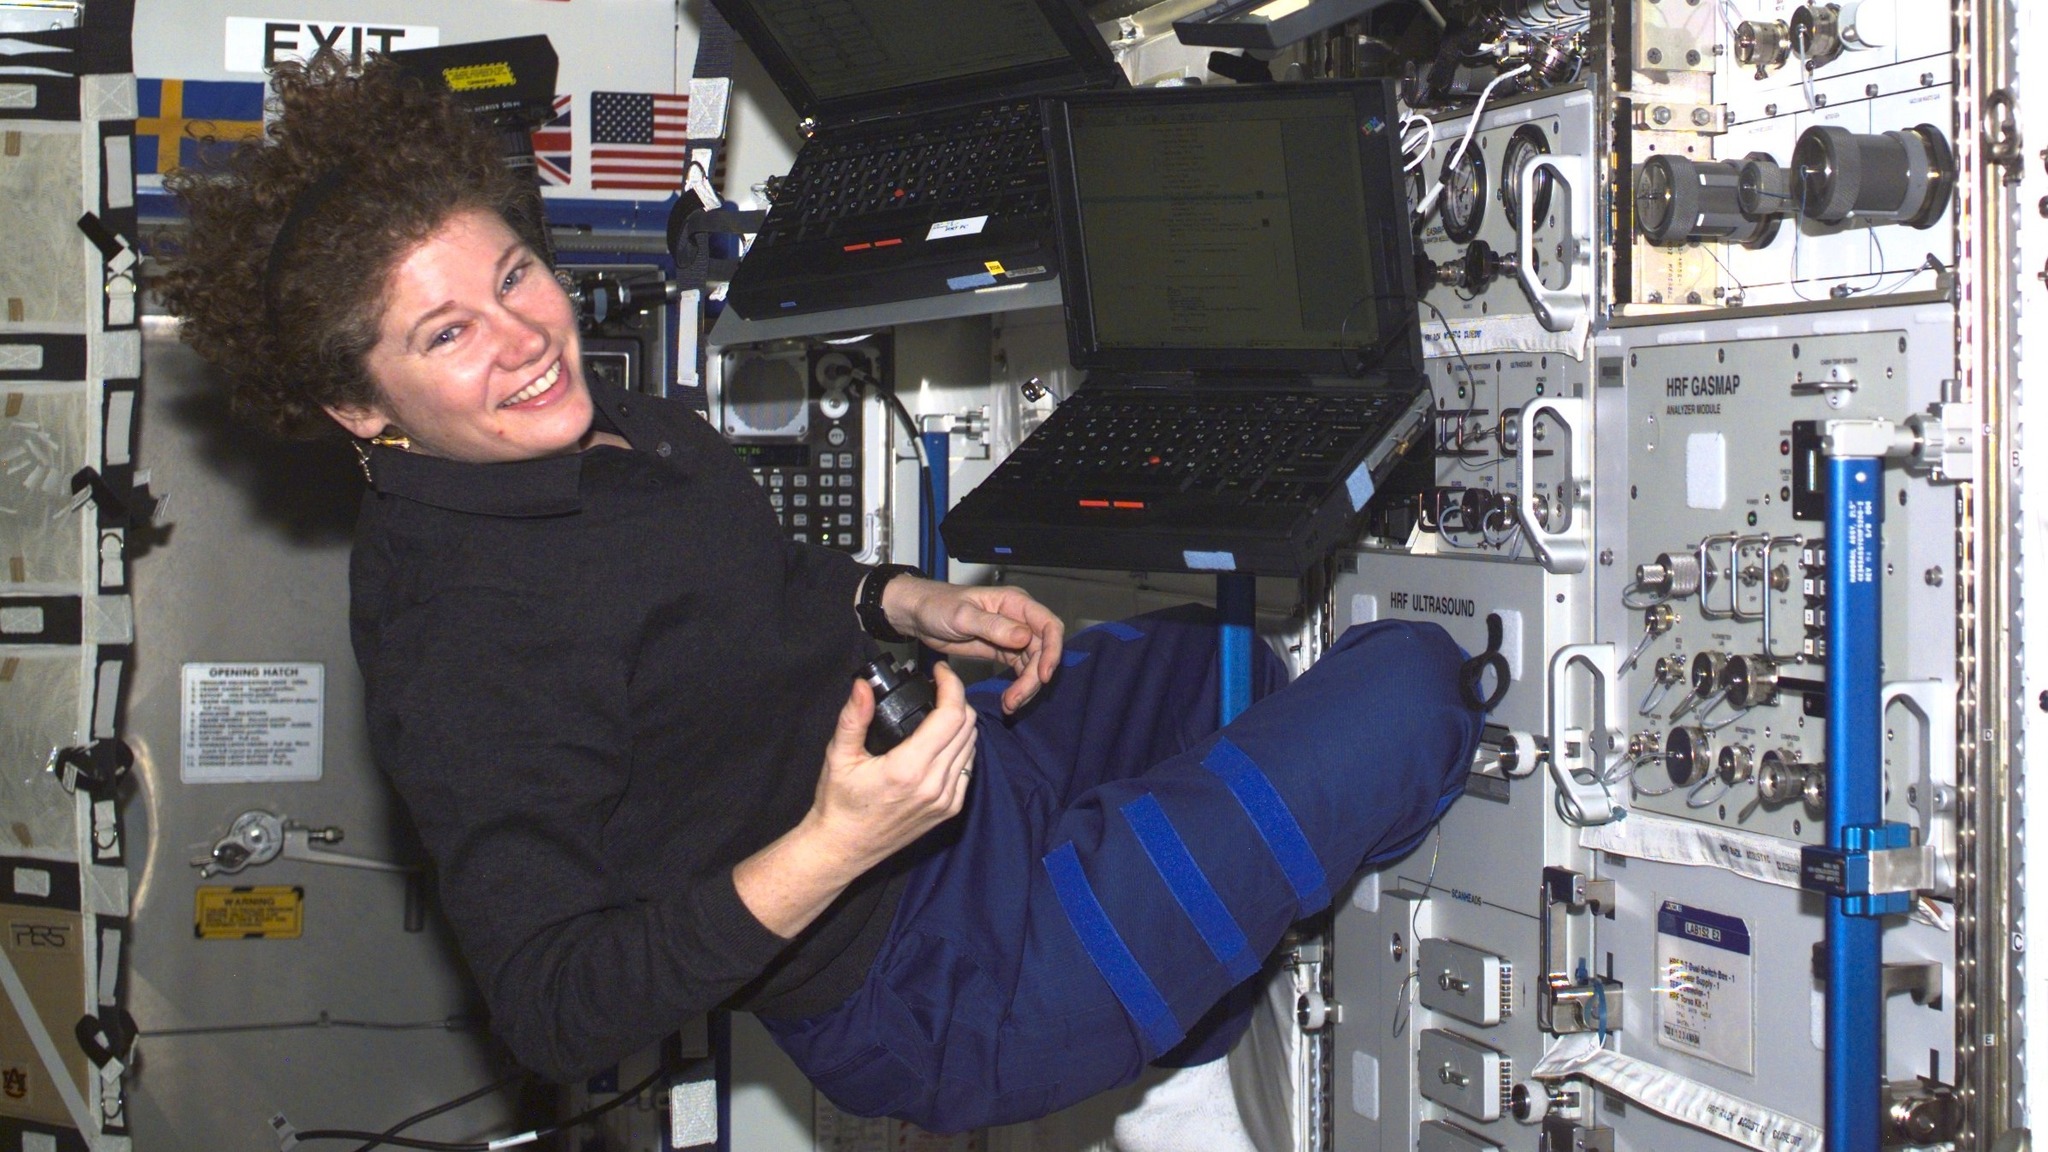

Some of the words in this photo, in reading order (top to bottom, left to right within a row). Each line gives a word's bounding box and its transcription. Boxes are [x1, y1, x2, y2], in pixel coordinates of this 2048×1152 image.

[264, 22, 406, 71] EXIT
[1360, 116, 1380, 136] IBM
[1666, 377, 1688, 397] HRF
[1692, 374, 1740, 396] GASMAP
[1666, 405, 1695, 415] ANALYZER
[1697, 404, 1721, 414] MODULE
[1390, 592, 1408, 609] HRF
[1412, 594, 1475, 617] ULTRASOUND
[209, 667, 259, 677] OPENING
[264, 667, 298, 677] HATCH
[224, 898, 275, 906] WARNING
[1451, 888, 1482, 906] SCANHEADS
[1686, 923, 1709, 938] LAB1S2
[1712, 929, 1720, 941] E2
[2014, 934, 2022, 950] C
[1689, 962, 1700, 973] Dual
[1701, 966, 1717, 978] Switch
[1718, 970, 1728, 981] Box
[1696, 976, 1712, 990] Supply
[1985, 1036, 1992, 1044] E
